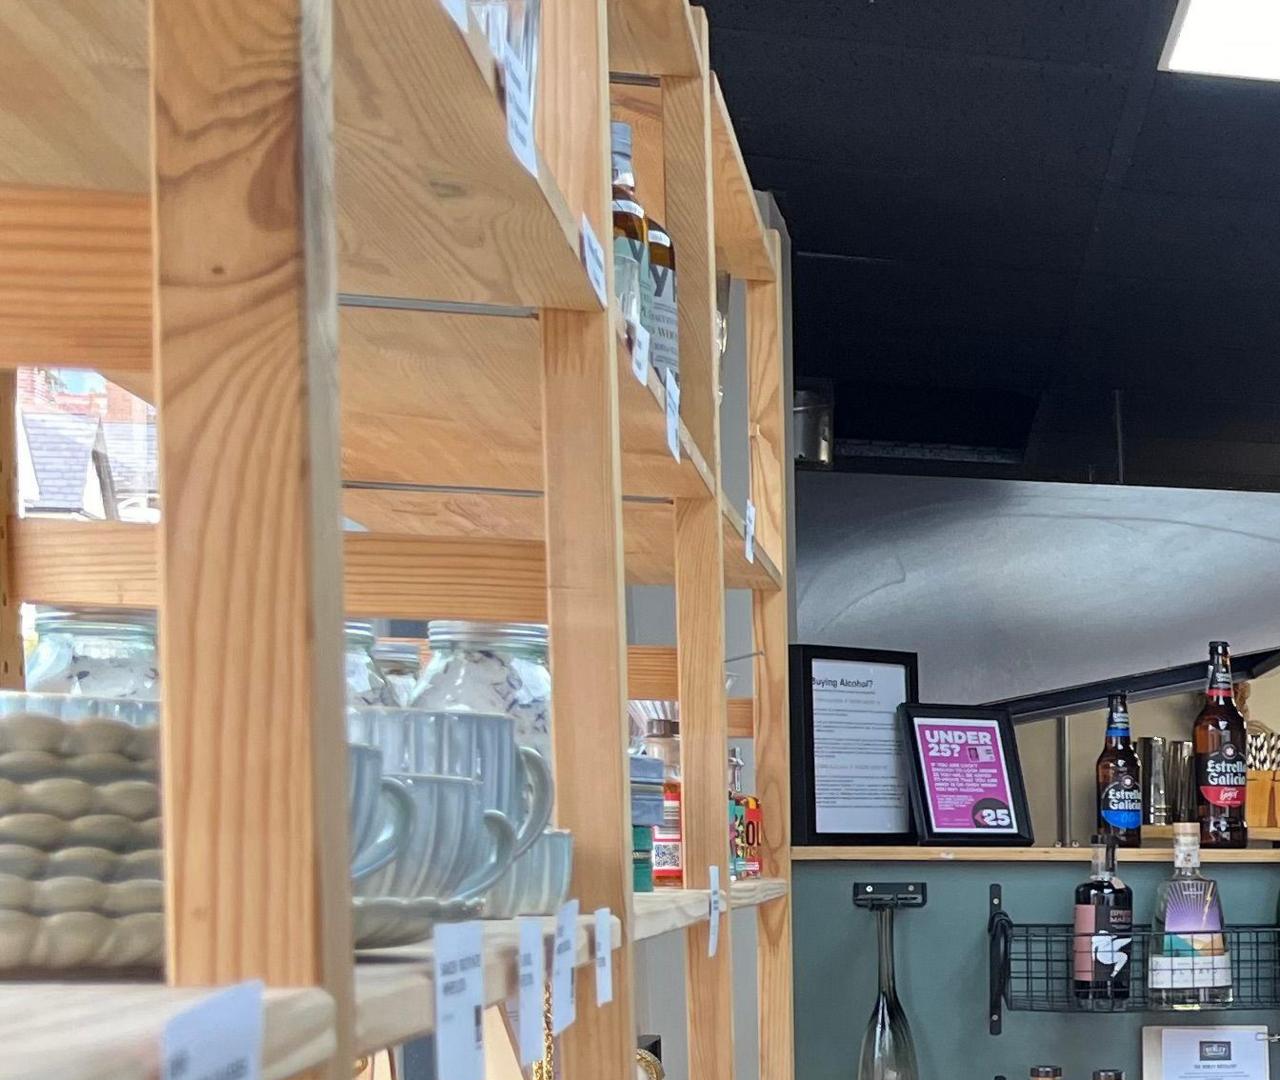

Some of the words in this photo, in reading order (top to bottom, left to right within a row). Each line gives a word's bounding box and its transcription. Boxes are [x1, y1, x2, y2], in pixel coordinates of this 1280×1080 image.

[925, 730, 992, 745] UNDER
[928, 744, 961, 757] 25?
[982, 809, 1010, 826] 25
